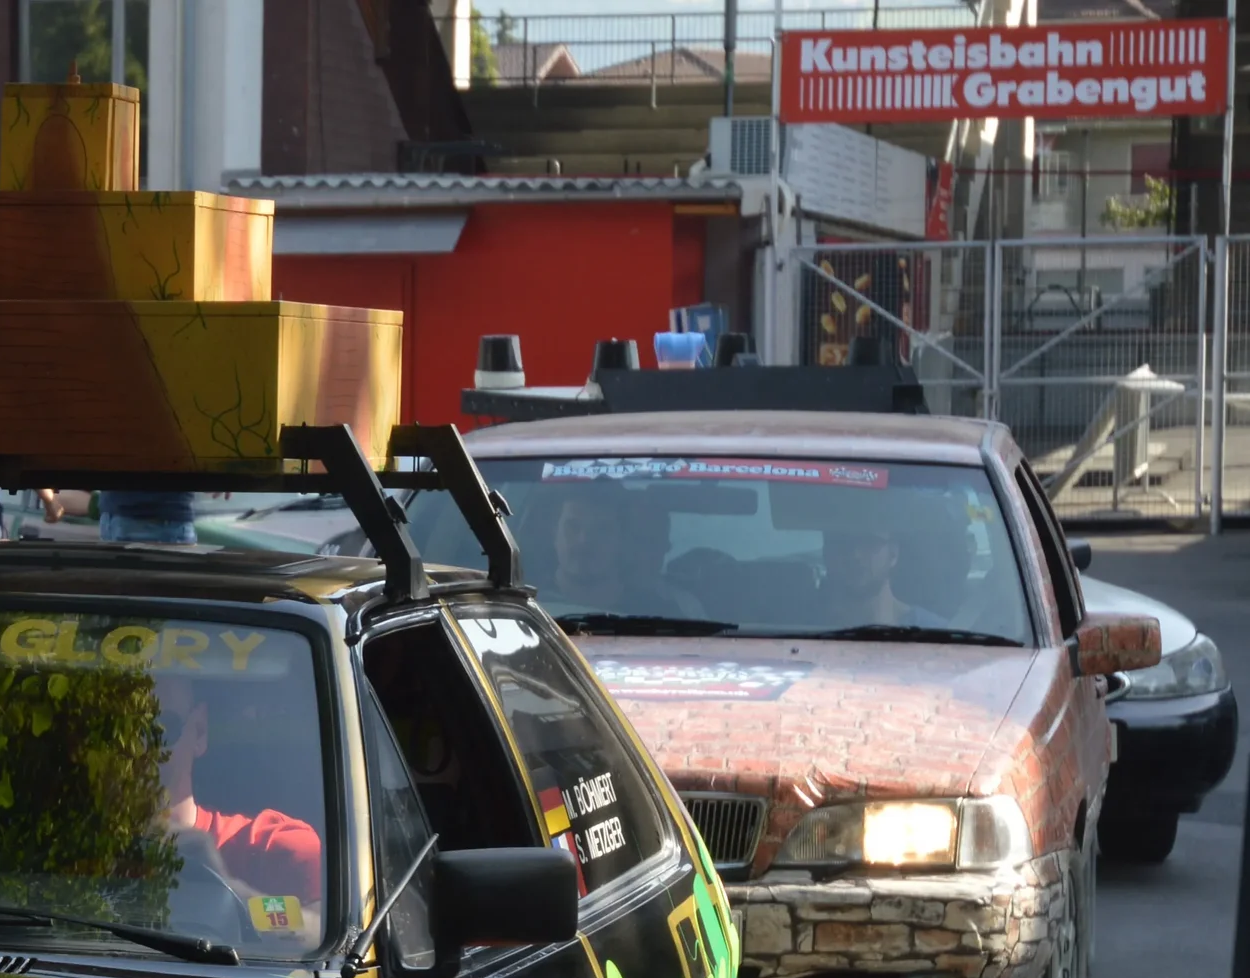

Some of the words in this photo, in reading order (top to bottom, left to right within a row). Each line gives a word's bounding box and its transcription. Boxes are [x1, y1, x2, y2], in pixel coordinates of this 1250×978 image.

[800, 32, 1104, 73] Kunsteisbahn
[962, 70, 1207, 112] Grabengut
[688, 462, 820, 478] Barcelona
[0, 617, 266, 671] GLORY
[562, 789, 578, 820] M.
[573, 772, 617, 815] BÖHMERT
[575, 834, 588, 864] S.
[585, 817, 626, 860] METZGER
[266, 912, 289, 927] 15
